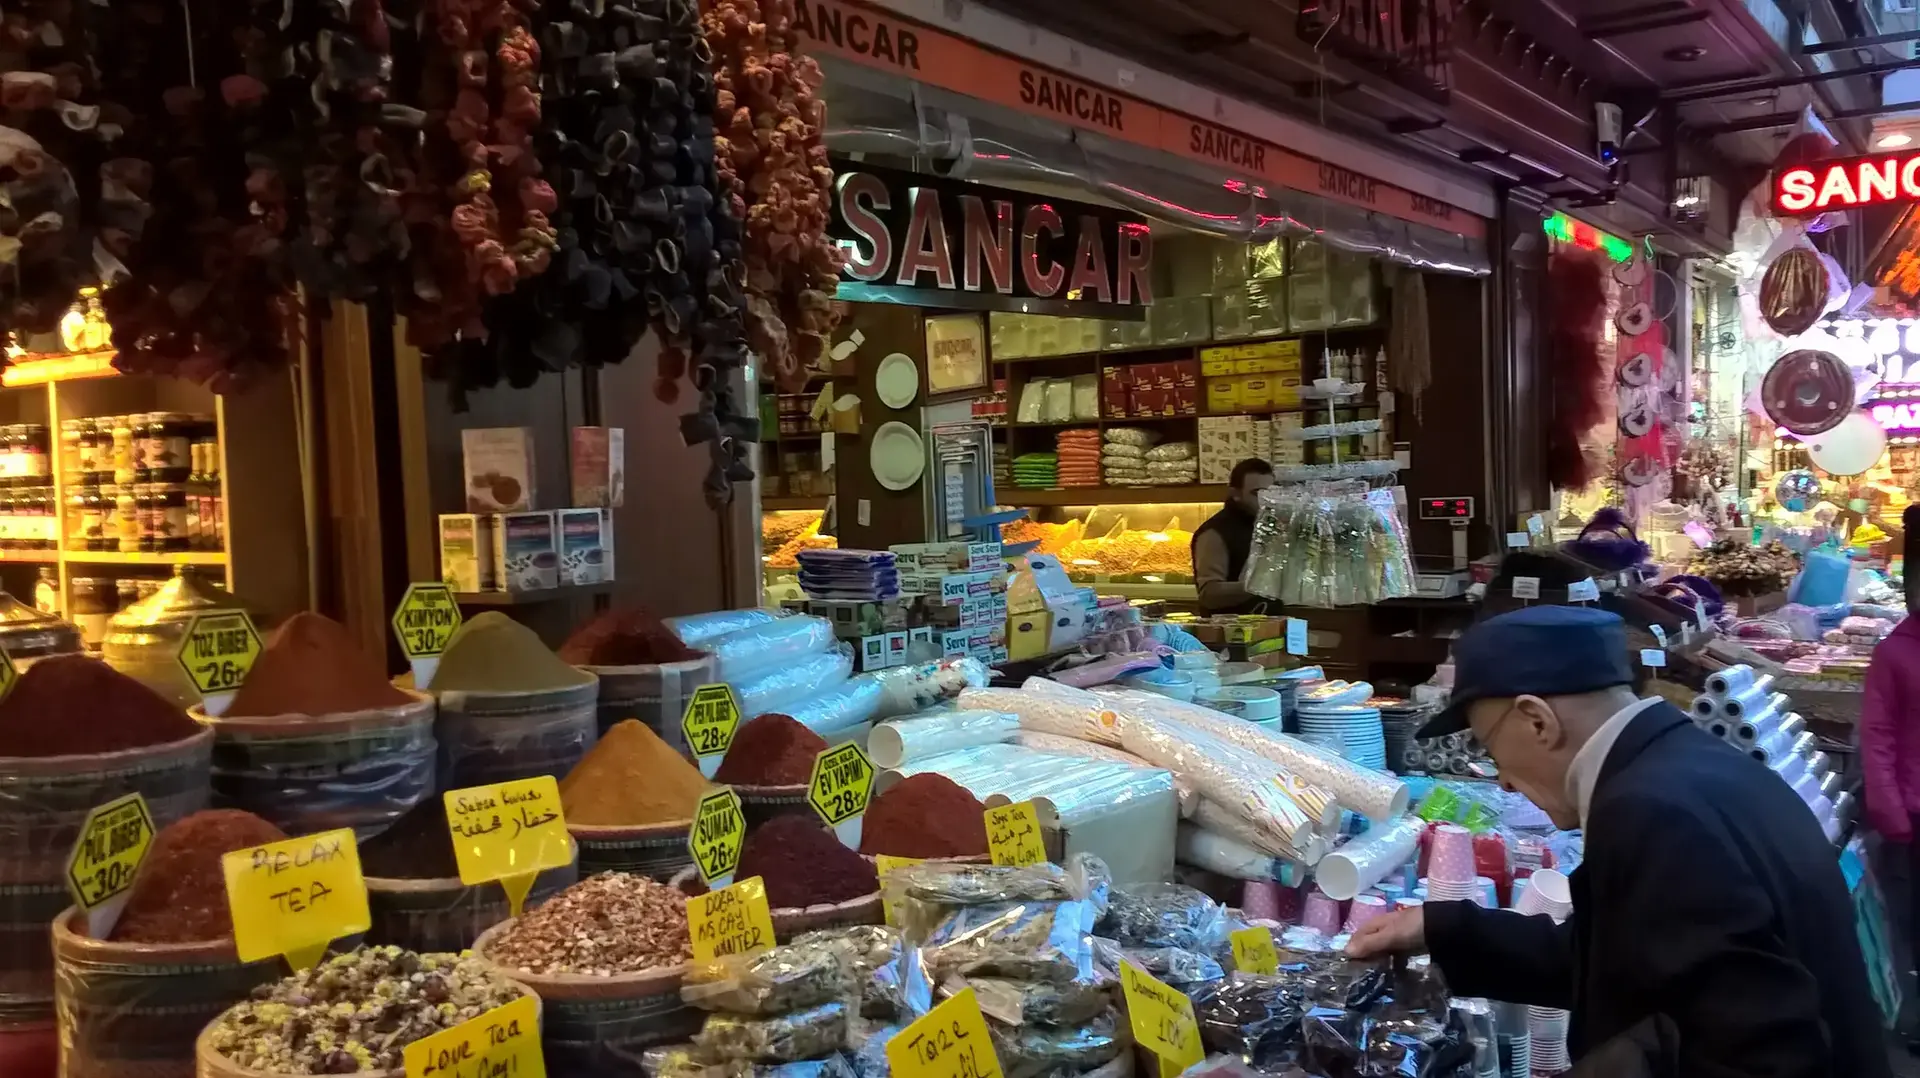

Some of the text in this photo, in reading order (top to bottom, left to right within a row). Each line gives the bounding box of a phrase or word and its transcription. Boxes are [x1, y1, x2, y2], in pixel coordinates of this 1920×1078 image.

[791, 0, 920, 70] ANCAR
[1020, 70, 1124, 131] SANCAR
[1190, 125, 1266, 173] SANCAR
[1318, 162, 1376, 204] SANCAR
[1410, 194, 1454, 221] SANCAR
[836, 171, 1154, 306] SANCAR
[944, 583, 965, 596] Sera
[945, 637, 966, 650] Sera
[820, 770, 832, 796] EV
[699, 808, 737, 846] SUMAK
[251, 840, 345, 877] RELAX
[270, 880, 333, 914] TEA
[423, 1019, 522, 1077] Love Tea
